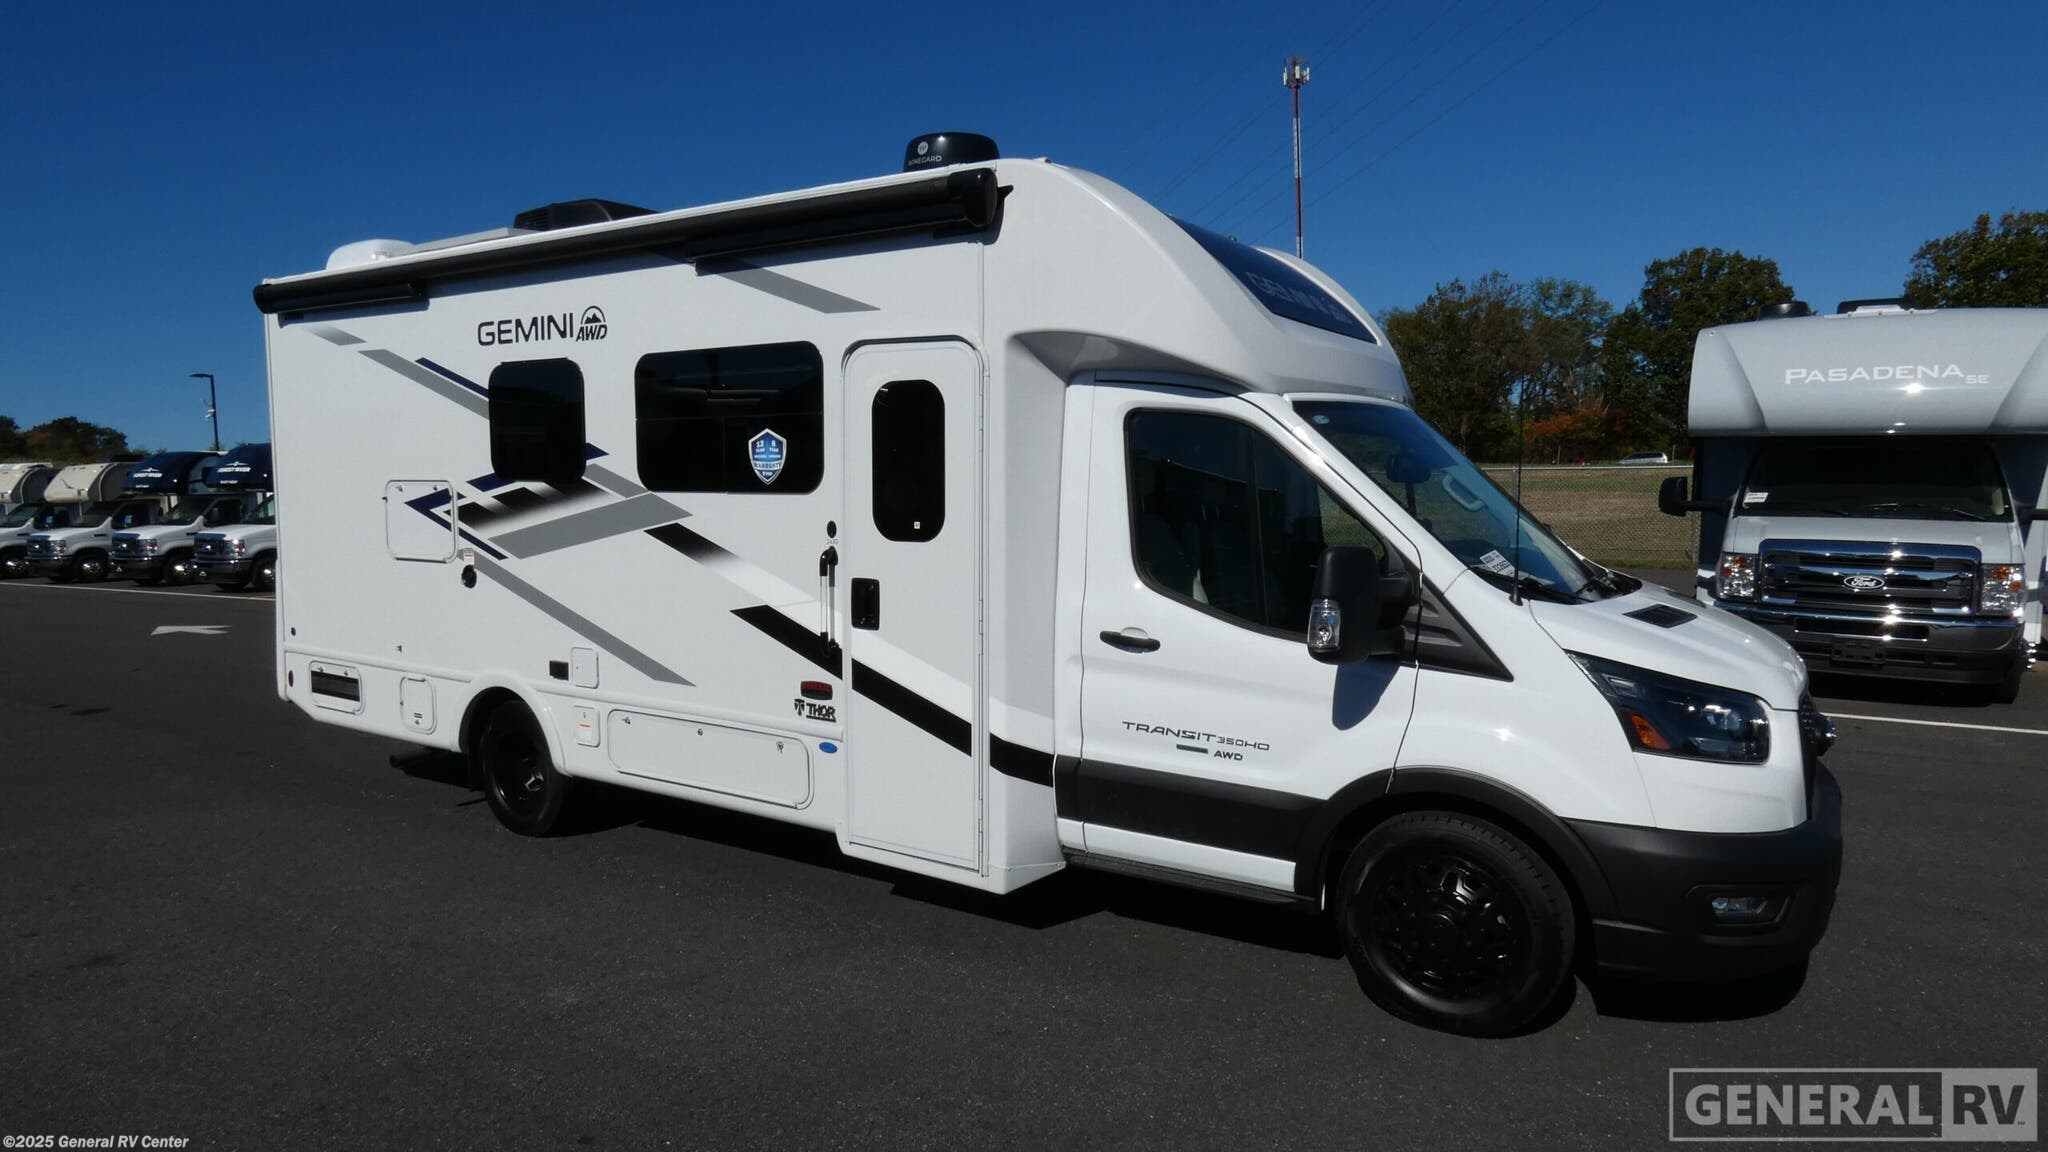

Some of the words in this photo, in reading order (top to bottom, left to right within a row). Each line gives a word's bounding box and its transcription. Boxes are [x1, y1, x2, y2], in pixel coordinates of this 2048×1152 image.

[477, 312, 574, 346] GEMINI
[576, 323, 608, 342] AWD
[1784, 364, 1964, 385] PASADENA
[1966, 375, 1990, 384] SE
[1850, 576, 1877, 587] Ford
[806, 702, 837, 723] THOR
[1122, 721, 1217, 742] TRANSIT
[1213, 750, 1243, 761] AWD
